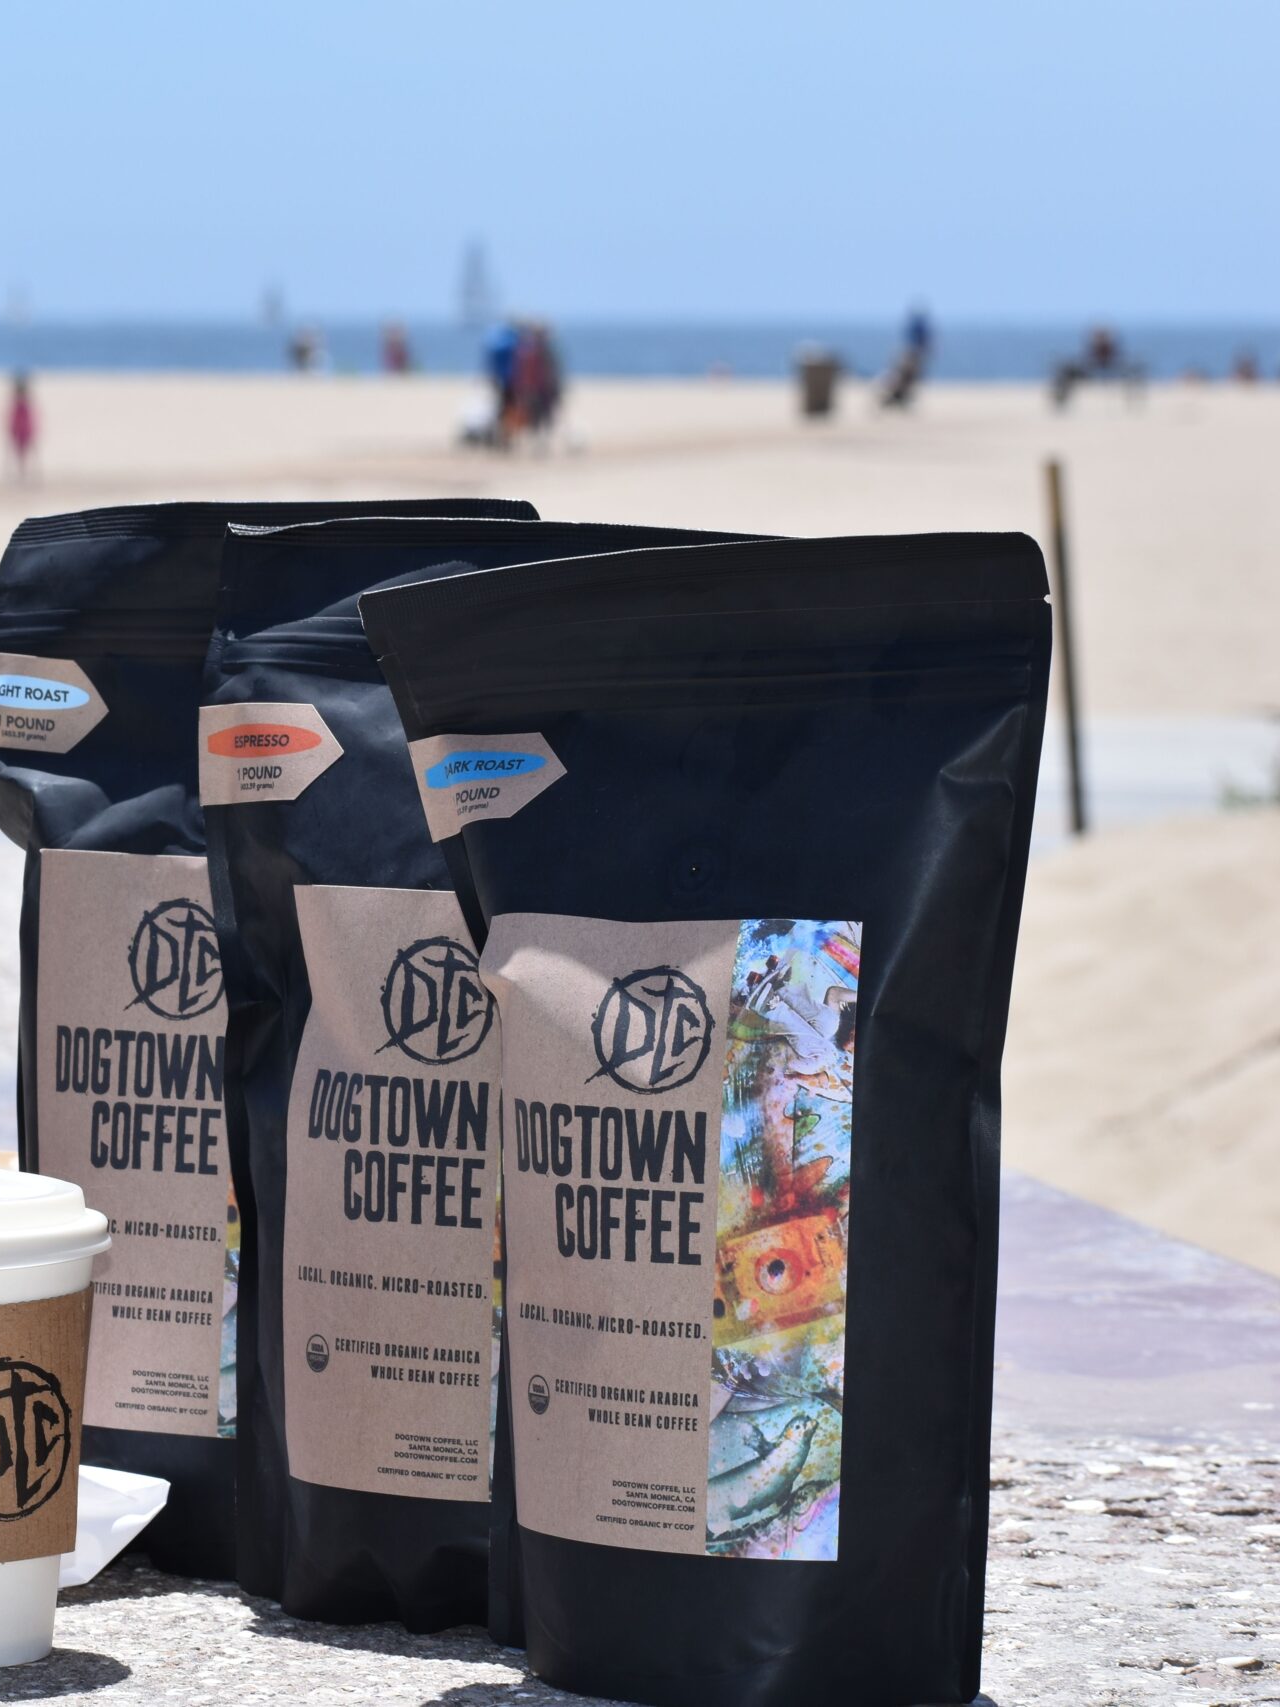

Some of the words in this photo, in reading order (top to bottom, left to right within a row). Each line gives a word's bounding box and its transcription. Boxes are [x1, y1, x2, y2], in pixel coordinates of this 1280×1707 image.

[24, 687, 69, 703] ROAST
[6, 716, 55, 732] POUND
[234, 734, 290, 749] ESPRESSO
[242, 766, 282, 780] POUND
[474, 759, 524, 772] ROAST
[455, 787, 500, 806] POUND
[56, 1025, 224, 1102] DOGTOWN
[308, 1068, 489, 1151] DOGTOWN
[90, 1101, 222, 1175] COFFEE
[515, 1098, 707, 1184] DOGTOWN
[344, 1148, 485, 1229] COFFEE
[124, 1220, 222, 1242] MICRO-ROASTED.
[555, 1183, 704, 1266] COFFEE
[298, 1265, 326, 1284] LOCAL.
[330, 1270, 376, 1290] ORGANIC.
[382, 1276, 487, 1300] MICRO-ROASTED.
[125, 1284, 166, 1300] ORGANIC
[170, 1288, 213, 1304] ARABICA
[112, 1305, 142, 1320] WHOLE
[146, 1308, 171, 1323] BEAN
[175, 1310, 212, 1326] COFFEE
[520, 1302, 549, 1323] LOCAL.
[553, 1308, 594, 1330] ORGANIC.
[598, 1316, 706, 1340] MICRO-ROASTED.
[335, 1338, 380, 1356] CERTIFIED
[384, 1344, 429, 1360] ORGANIC
[433, 1348, 480, 1364] ARABICA
[132, 1370, 166, 1379] DOGTOWN
[145, 1379, 166, 1388] SANTA
[371, 1365, 404, 1381] WHOLE
[408, 1368, 435, 1384] BEAN
[440, 1370, 480, 1387] COFFEE
[555, 1379, 598, 1398] CERTIFIED
[600, 1386, 645, 1404] ORGANIC
[650, 1390, 698, 1408] ARABICA
[115, 1402, 146, 1411] CERTIFIED
[147, 1404, 178, 1414] ORGANIC
[190, 1408, 208, 1416] CCOF
[588, 1408, 620, 1426] WHOLE
[624, 1412, 652, 1429] BEAN
[656, 1416, 698, 1432] COFFEE
[395, 1433, 431, 1444] DOGTOWN
[433, 1436, 464, 1446] COFFEE,
[394, 1451, 478, 1464] DOGTOWNCOFFEE.COM
[408, 1444, 431, 1452] SANTA
[433, 1446, 465, 1456] MONICA,
[468, 1448, 478, 1456] CA
[378, 1467, 410, 1476] CERTIFIED
[411, 1470, 444, 1480] ORGANIC
[446, 1472, 456, 1480] BY
[457, 1474, 478, 1482] CCOF
[612, 1480, 648, 1490] DOGTOWN
[650, 1484, 680, 1494] COFFEE,
[682, 1486, 696, 1494] LLC
[612, 1499, 696, 1513] DOGTOWNCOFFEE.COM
[626, 1491, 648, 1500] SANTA
[650, 1494, 682, 1504] MONICA,
[684, 1496, 696, 1504] CA
[596, 1514, 627, 1525] CERTIFIED
[629, 1518, 661, 1528] ORGANIC
[663, 1522, 673, 1530] BY
[674, 1523, 695, 1531] CCOF
